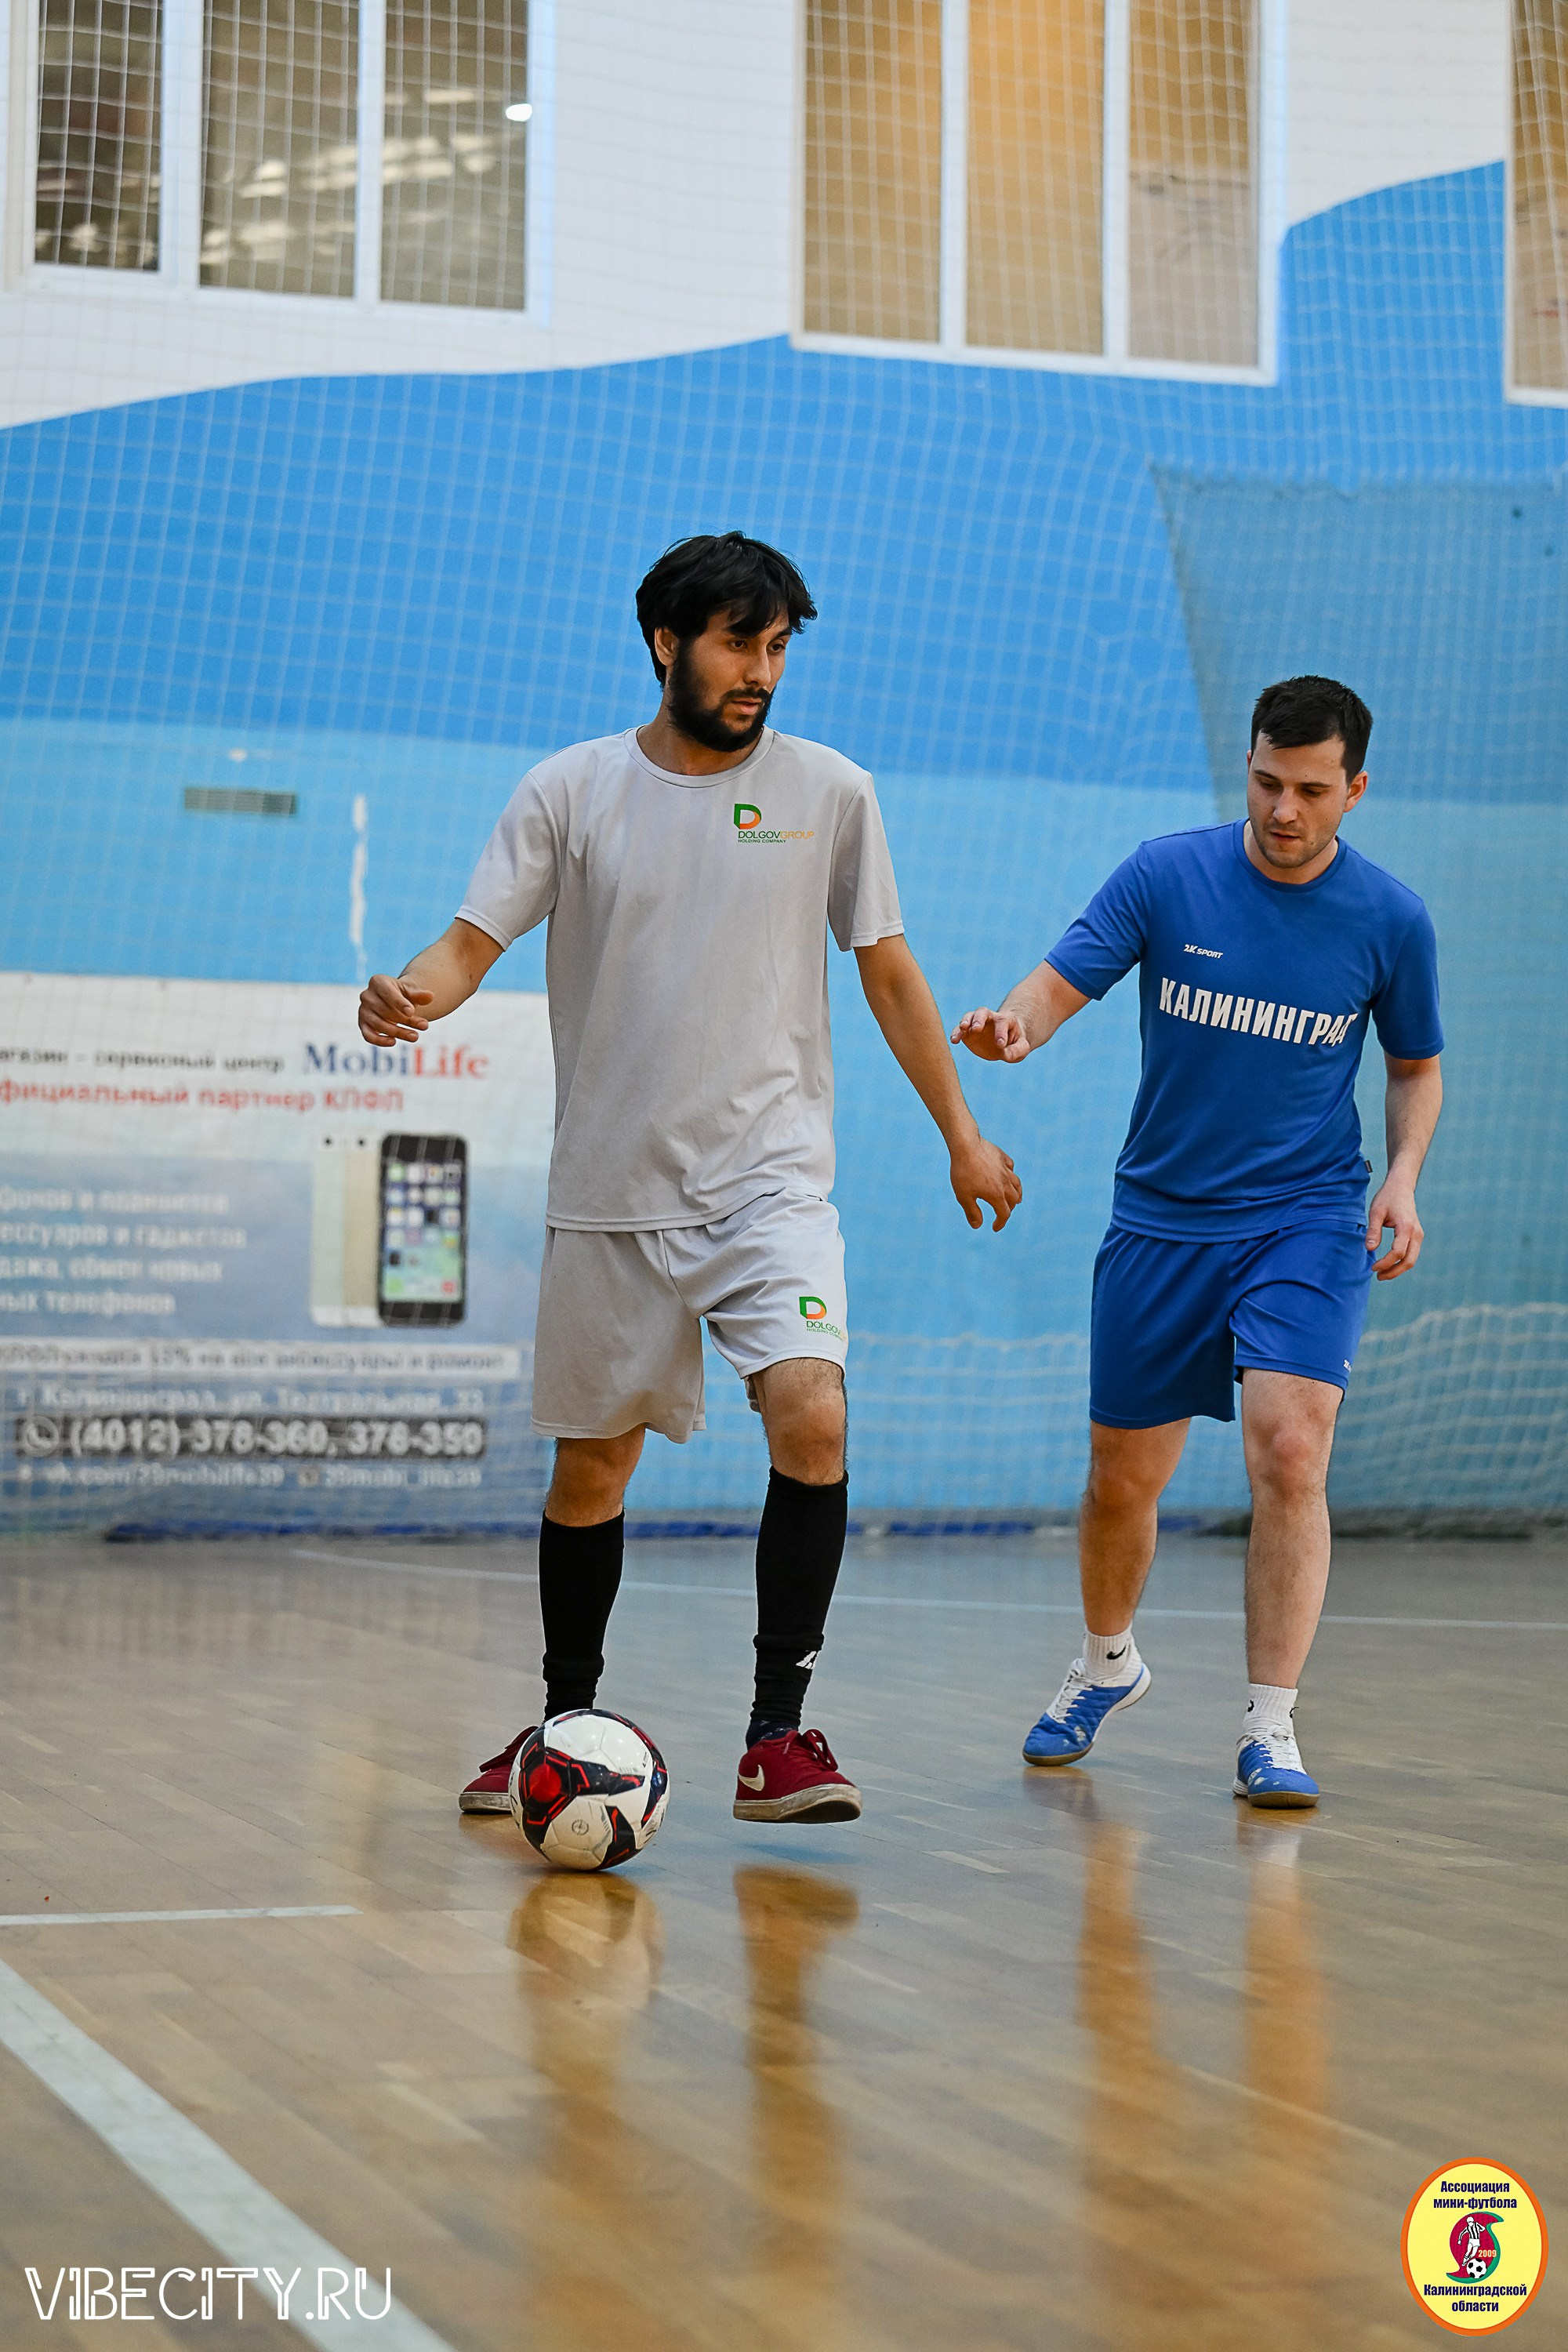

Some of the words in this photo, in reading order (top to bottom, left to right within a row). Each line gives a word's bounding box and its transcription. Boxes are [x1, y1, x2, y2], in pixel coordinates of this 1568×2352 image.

[738, 831, 815, 840] DOLGOVGROUP
[1196, 949, 1223, 959] SPORT
[303, 1043, 488, 1079] MobiLife
